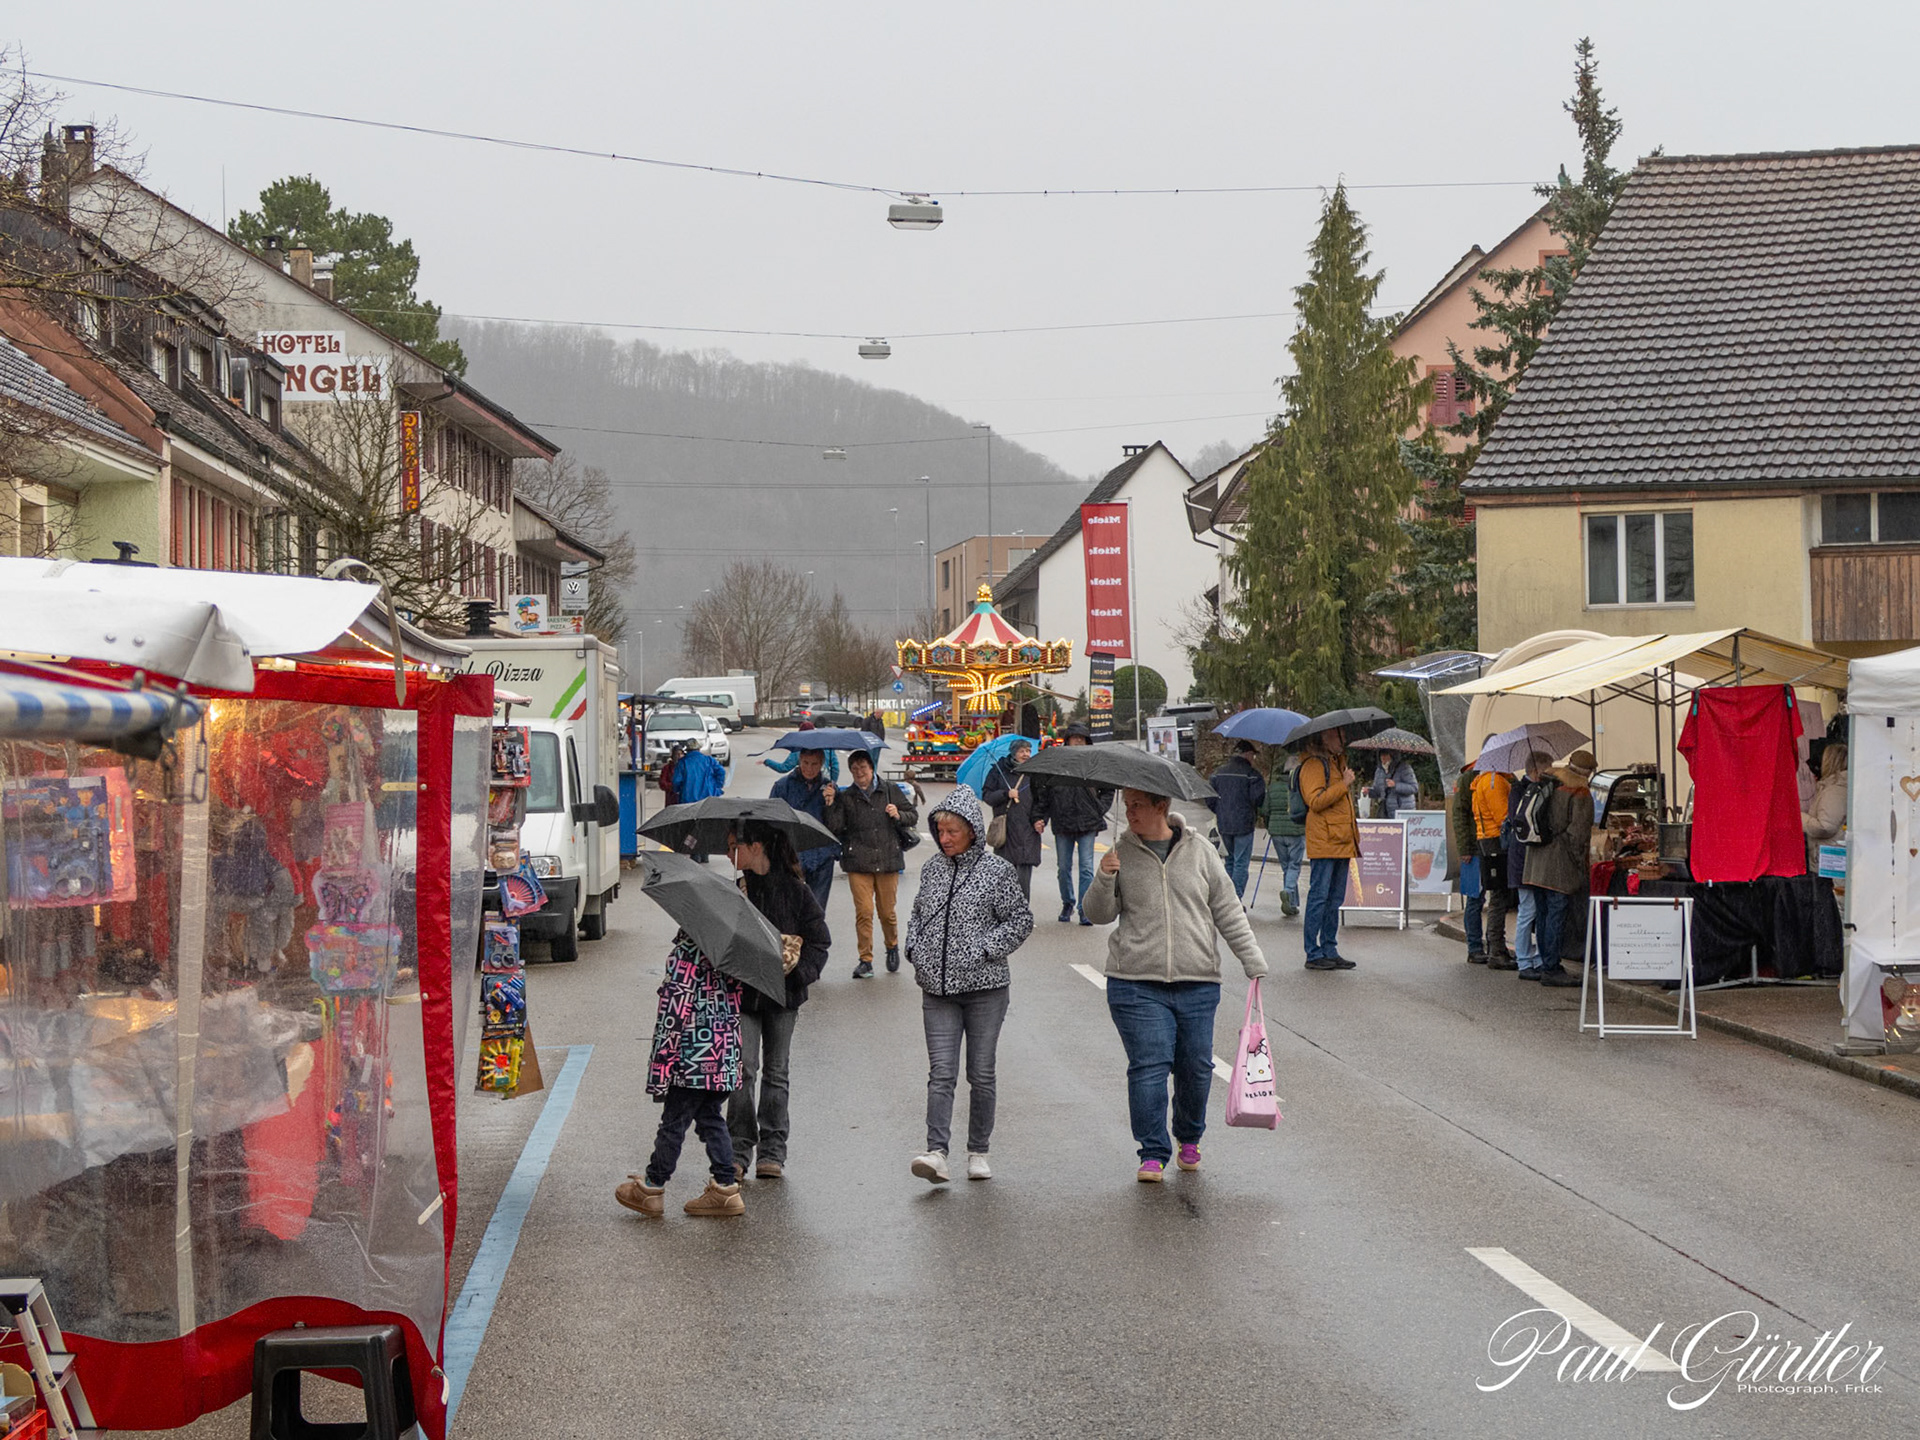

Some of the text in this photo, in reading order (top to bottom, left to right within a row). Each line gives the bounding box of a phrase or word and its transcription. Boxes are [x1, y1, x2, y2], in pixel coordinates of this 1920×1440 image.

[262, 334, 341, 355] HOTEL
[284, 364, 382, 394] NGEL
[1407, 816, 1426, 826] HOT
[1409, 827, 1443, 837] APEROL
